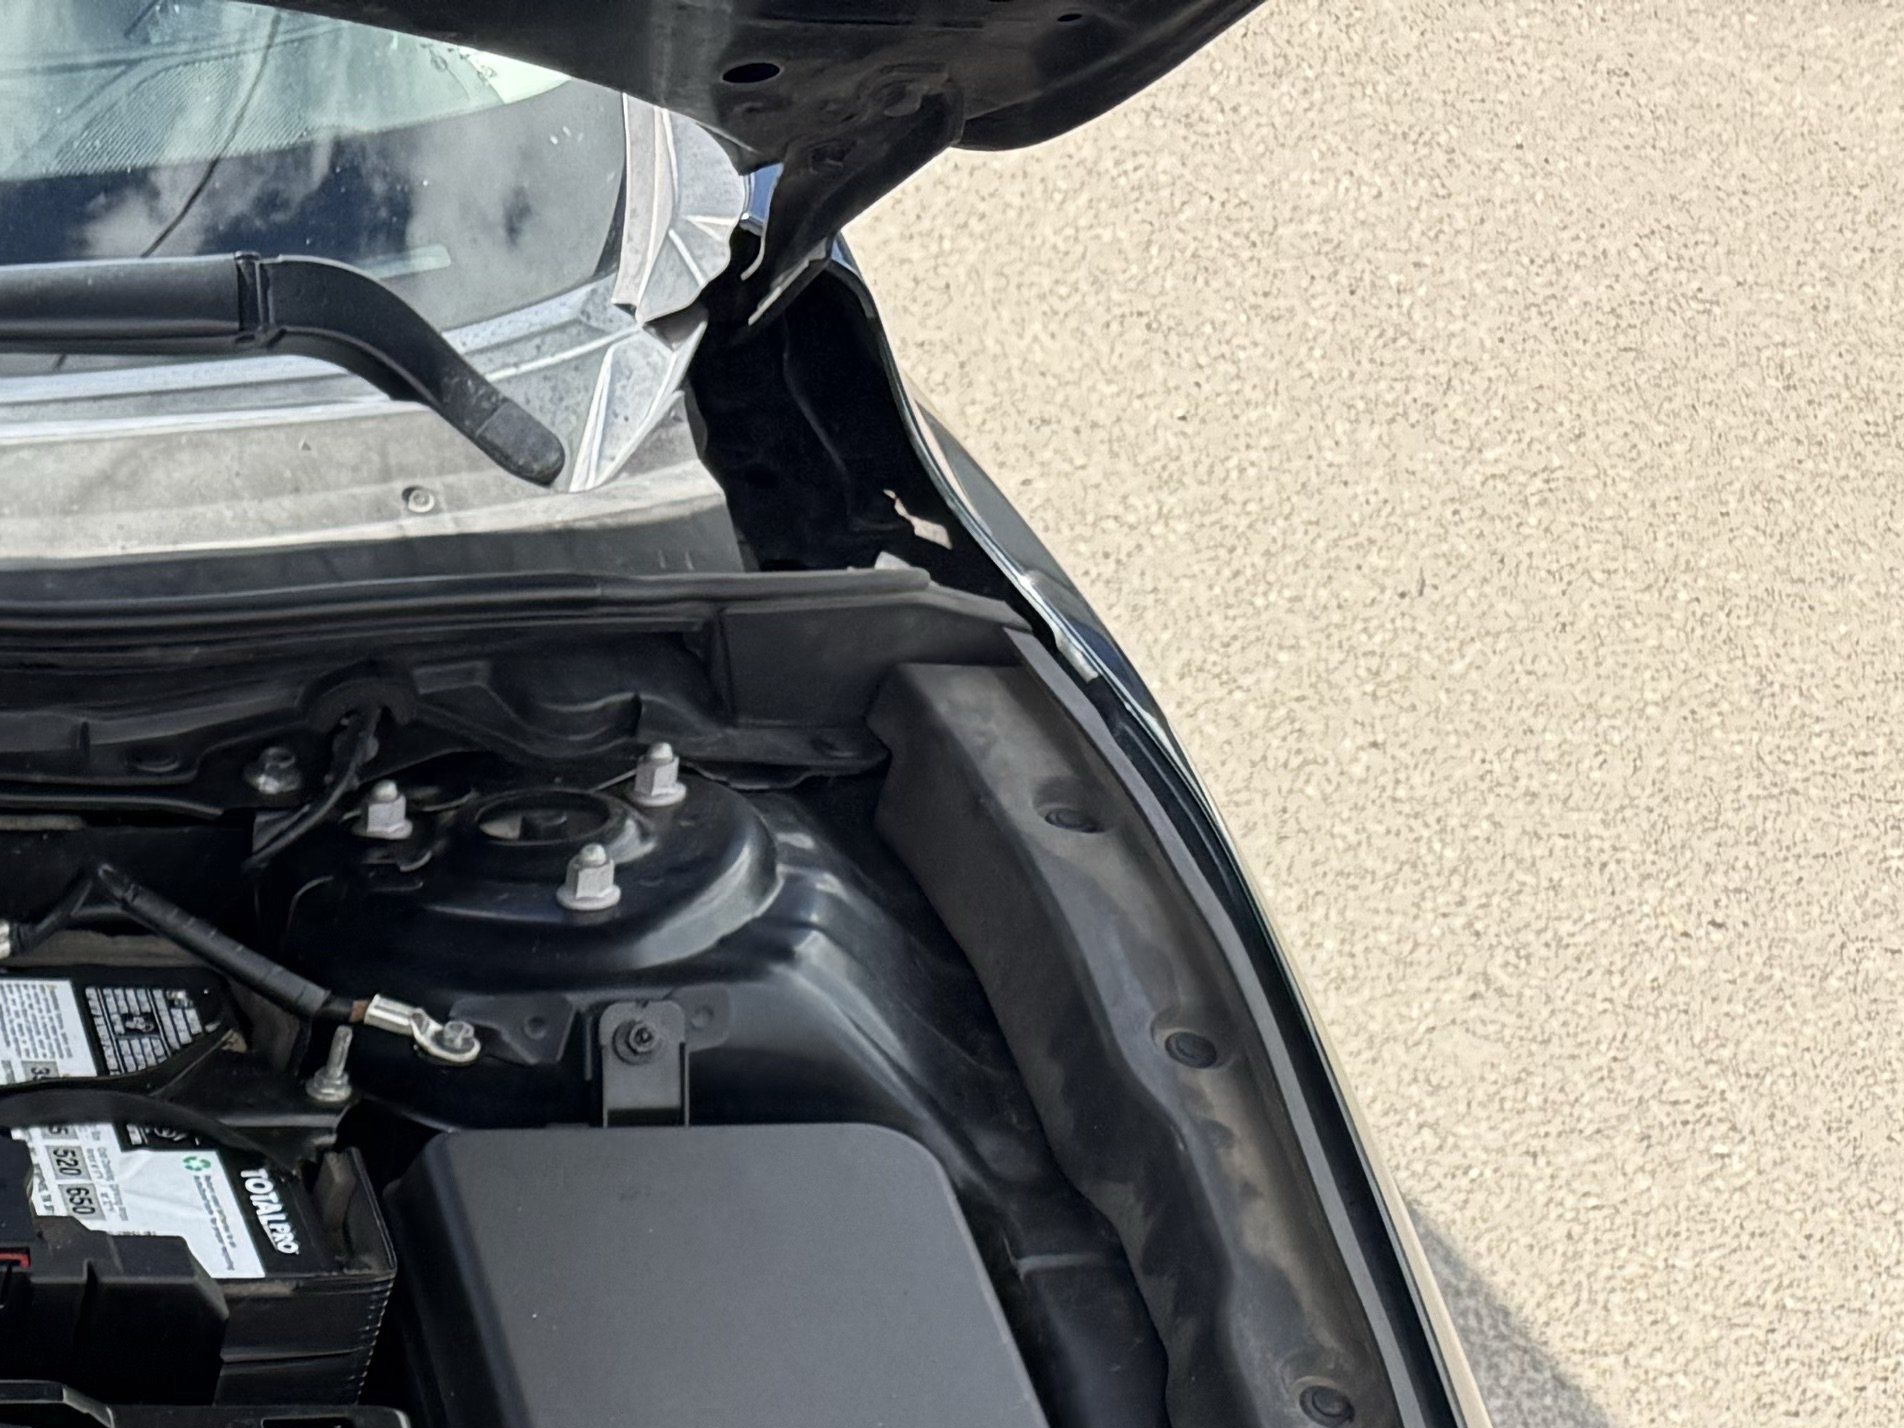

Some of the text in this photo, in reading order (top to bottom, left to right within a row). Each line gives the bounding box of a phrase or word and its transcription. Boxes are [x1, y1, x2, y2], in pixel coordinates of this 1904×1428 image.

[53, 1148, 82, 1177] 520
[66, 1186, 96, 1215] 650
[240, 1168, 299, 1254] TOTALPRO
